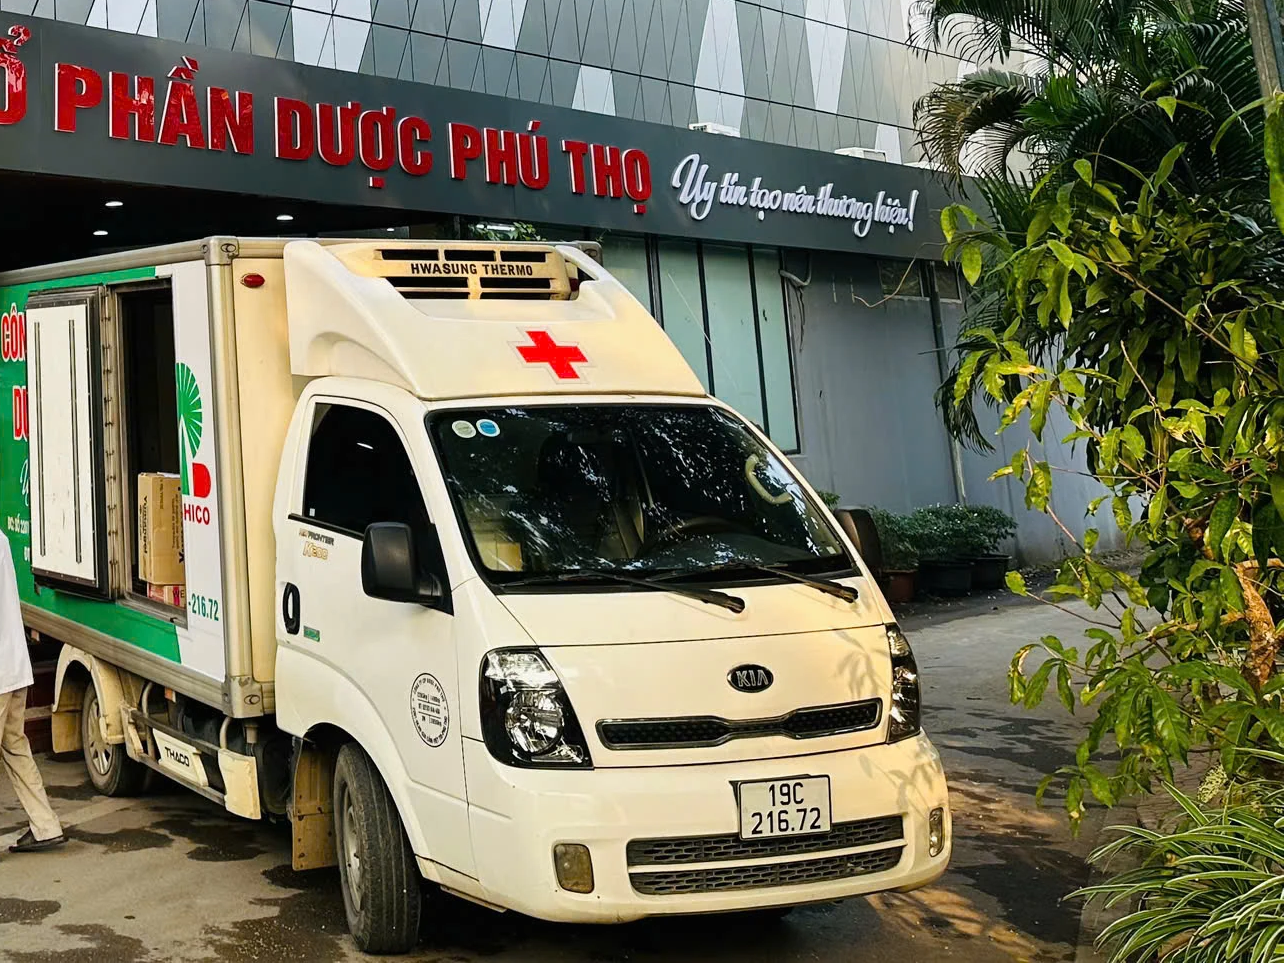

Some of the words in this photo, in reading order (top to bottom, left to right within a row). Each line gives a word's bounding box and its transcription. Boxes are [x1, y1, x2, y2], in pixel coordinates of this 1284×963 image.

[55, 56, 254, 155] PHẦN
[274, 97, 434, 189] DƯỢC
[448, 120, 550, 190] PHÚ
[562, 139, 653, 215] THỌ
[671, 153, 717, 221] Uy
[719, 172, 748, 206] tín
[749, 177, 782, 221] tạo
[783, 185, 815, 214] nên
[816, 183, 873, 237] thương
[410, 262, 477, 275] HWASUNG
[482, 263, 533, 276] THERMO
[735, 669, 769, 687] KIA
[165, 746, 190, 768] THACO
[768, 782, 805, 807] 19C
[751, 807, 821, 835] 216.72
